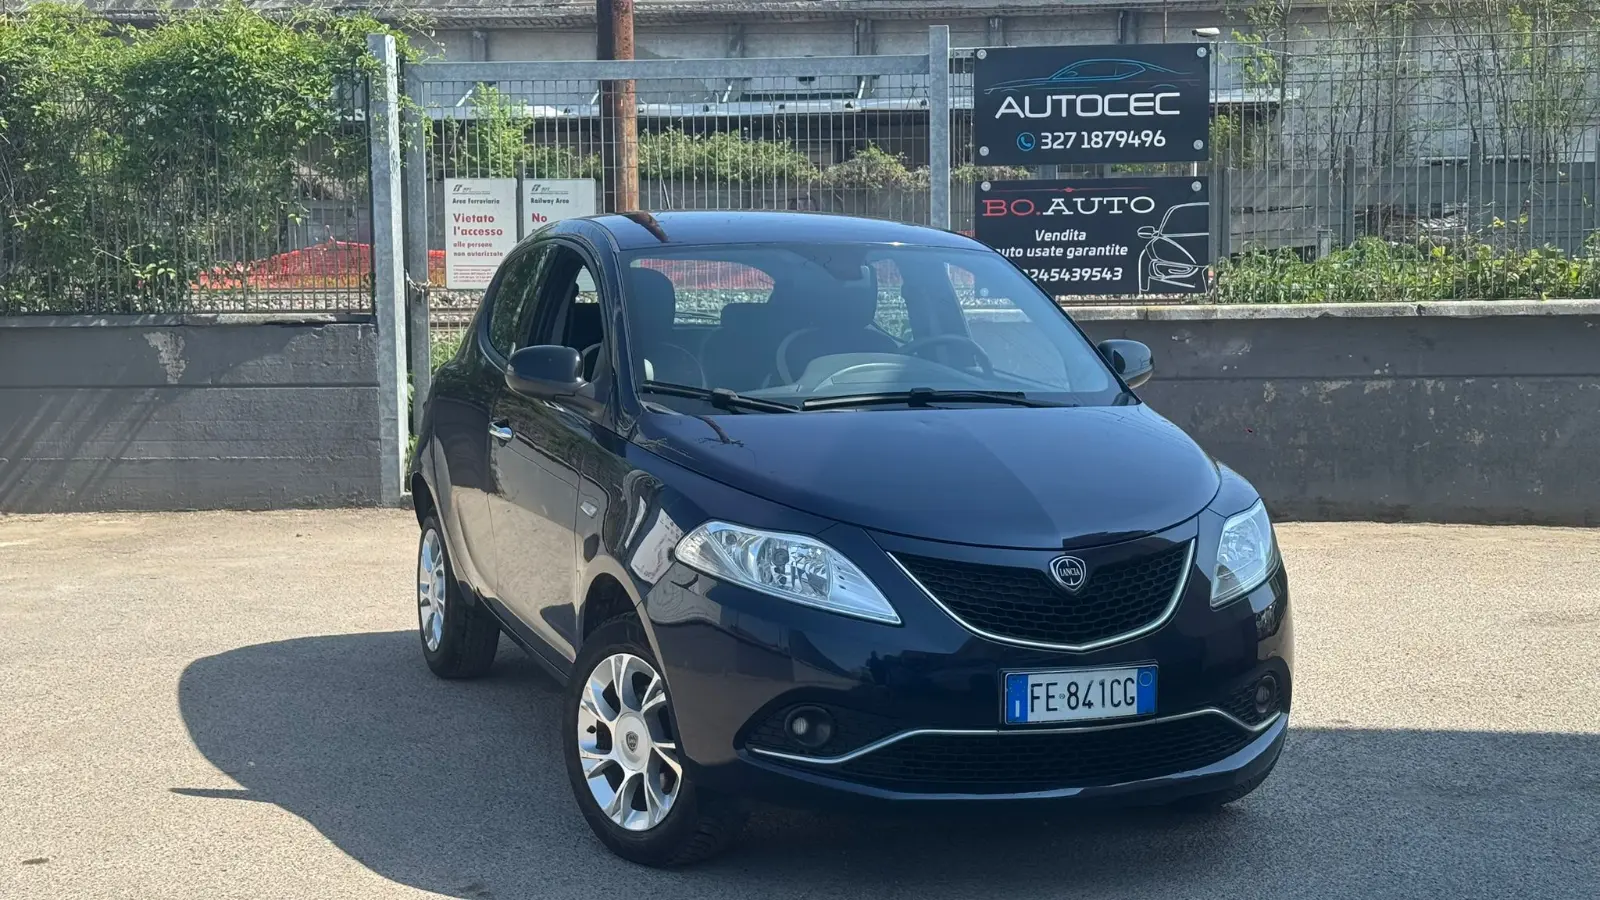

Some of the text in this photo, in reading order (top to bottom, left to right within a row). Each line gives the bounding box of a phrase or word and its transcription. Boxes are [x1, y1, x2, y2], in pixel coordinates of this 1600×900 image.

[995, 92, 1181, 119] AUTOCEC
[1040, 129, 1166, 149] 327 1879496
[982, 196, 1155, 216] BO.AUTO
[453, 213, 495, 223] Vietato
[531, 213, 548, 223] No
[453, 226, 503, 236] l'accesso
[1035, 229, 1087, 242] Vendita
[1026, 245, 1063, 258] usate
[1066, 243, 1129, 259] garantite
[1022, 267, 1123, 282] 245439543
[1059, 567, 1081, 577] LANCIA
